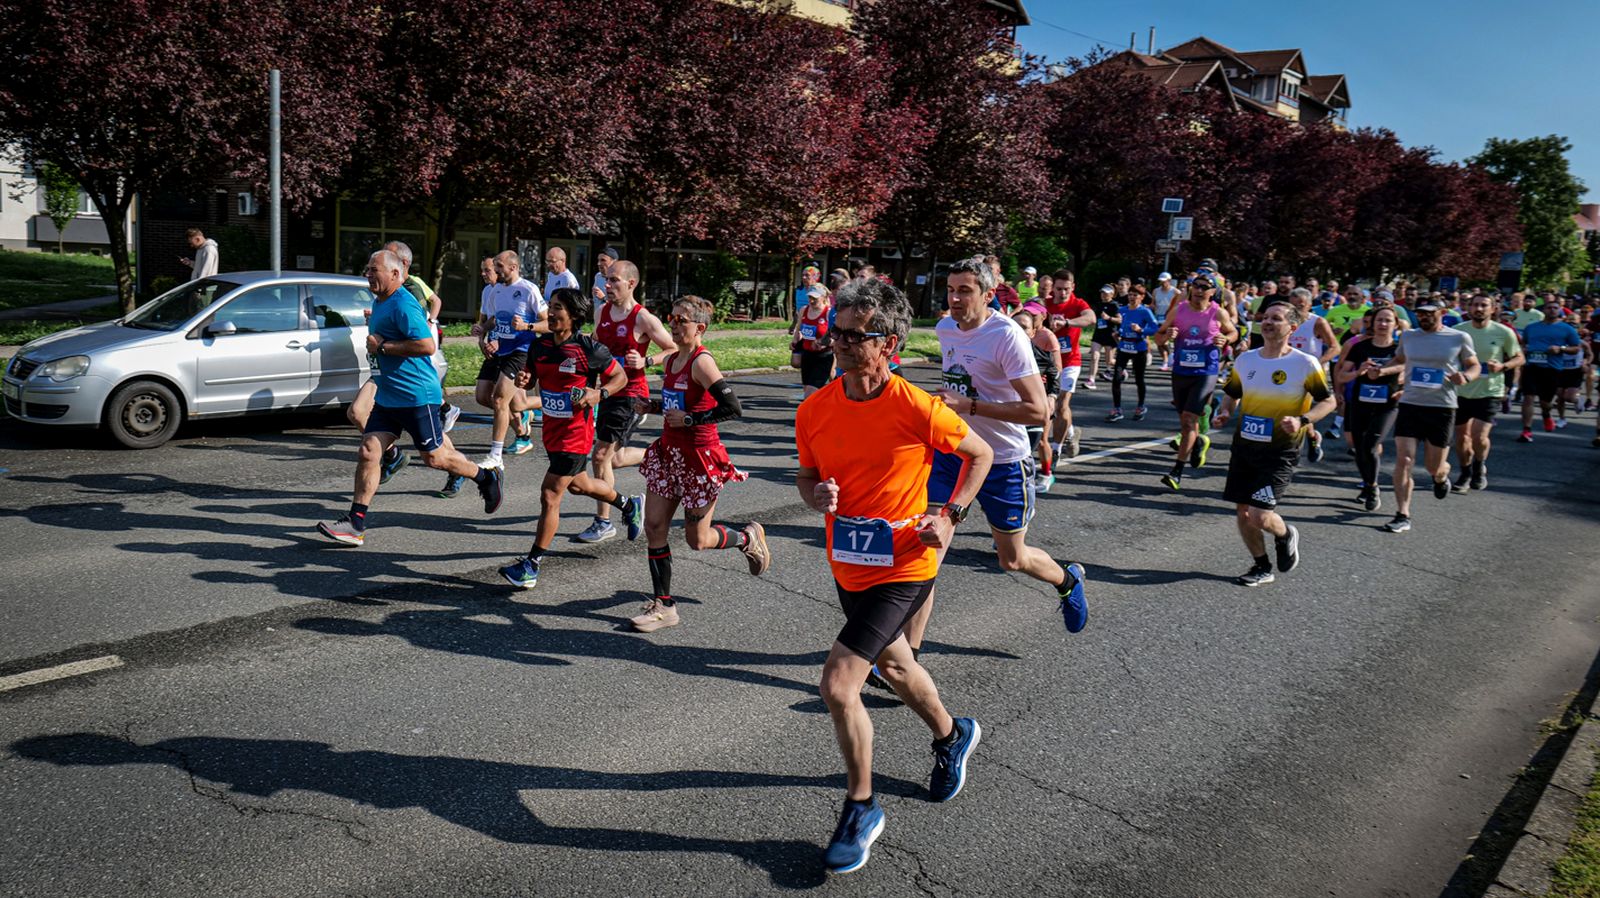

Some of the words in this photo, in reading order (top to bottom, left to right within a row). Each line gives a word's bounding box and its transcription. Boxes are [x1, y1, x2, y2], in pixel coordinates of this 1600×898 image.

[1185, 353, 1198, 362] 39
[1423, 373, 1430, 382] 9
[1369, 389, 1377, 397] 7
[543, 396, 565, 411] 289
[1244, 421, 1265, 435] 201
[847, 530, 874, 552] 17
